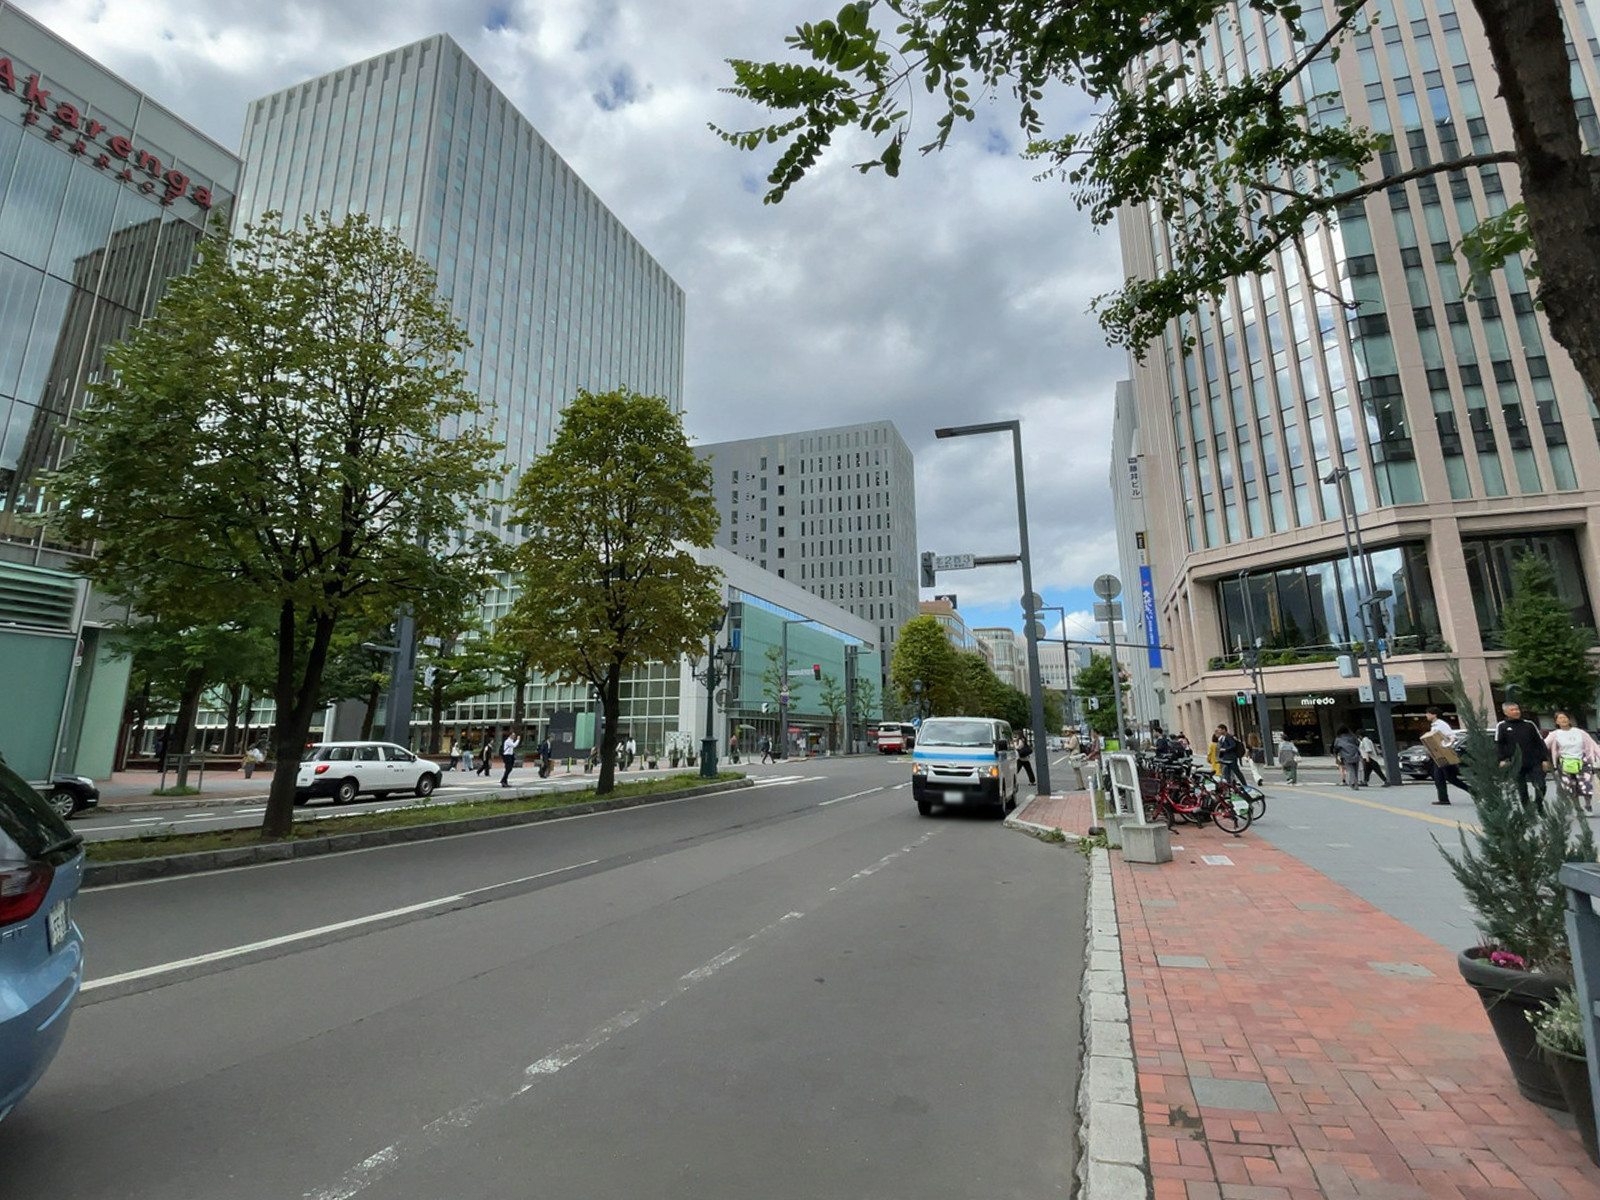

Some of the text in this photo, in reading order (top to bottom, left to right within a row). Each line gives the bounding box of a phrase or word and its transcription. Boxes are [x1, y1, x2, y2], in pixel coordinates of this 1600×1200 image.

[0, 57, 212, 209] Akarenga
[25, 112, 174, 206] TERRACE
[1300, 694, 1336, 706] miredo
